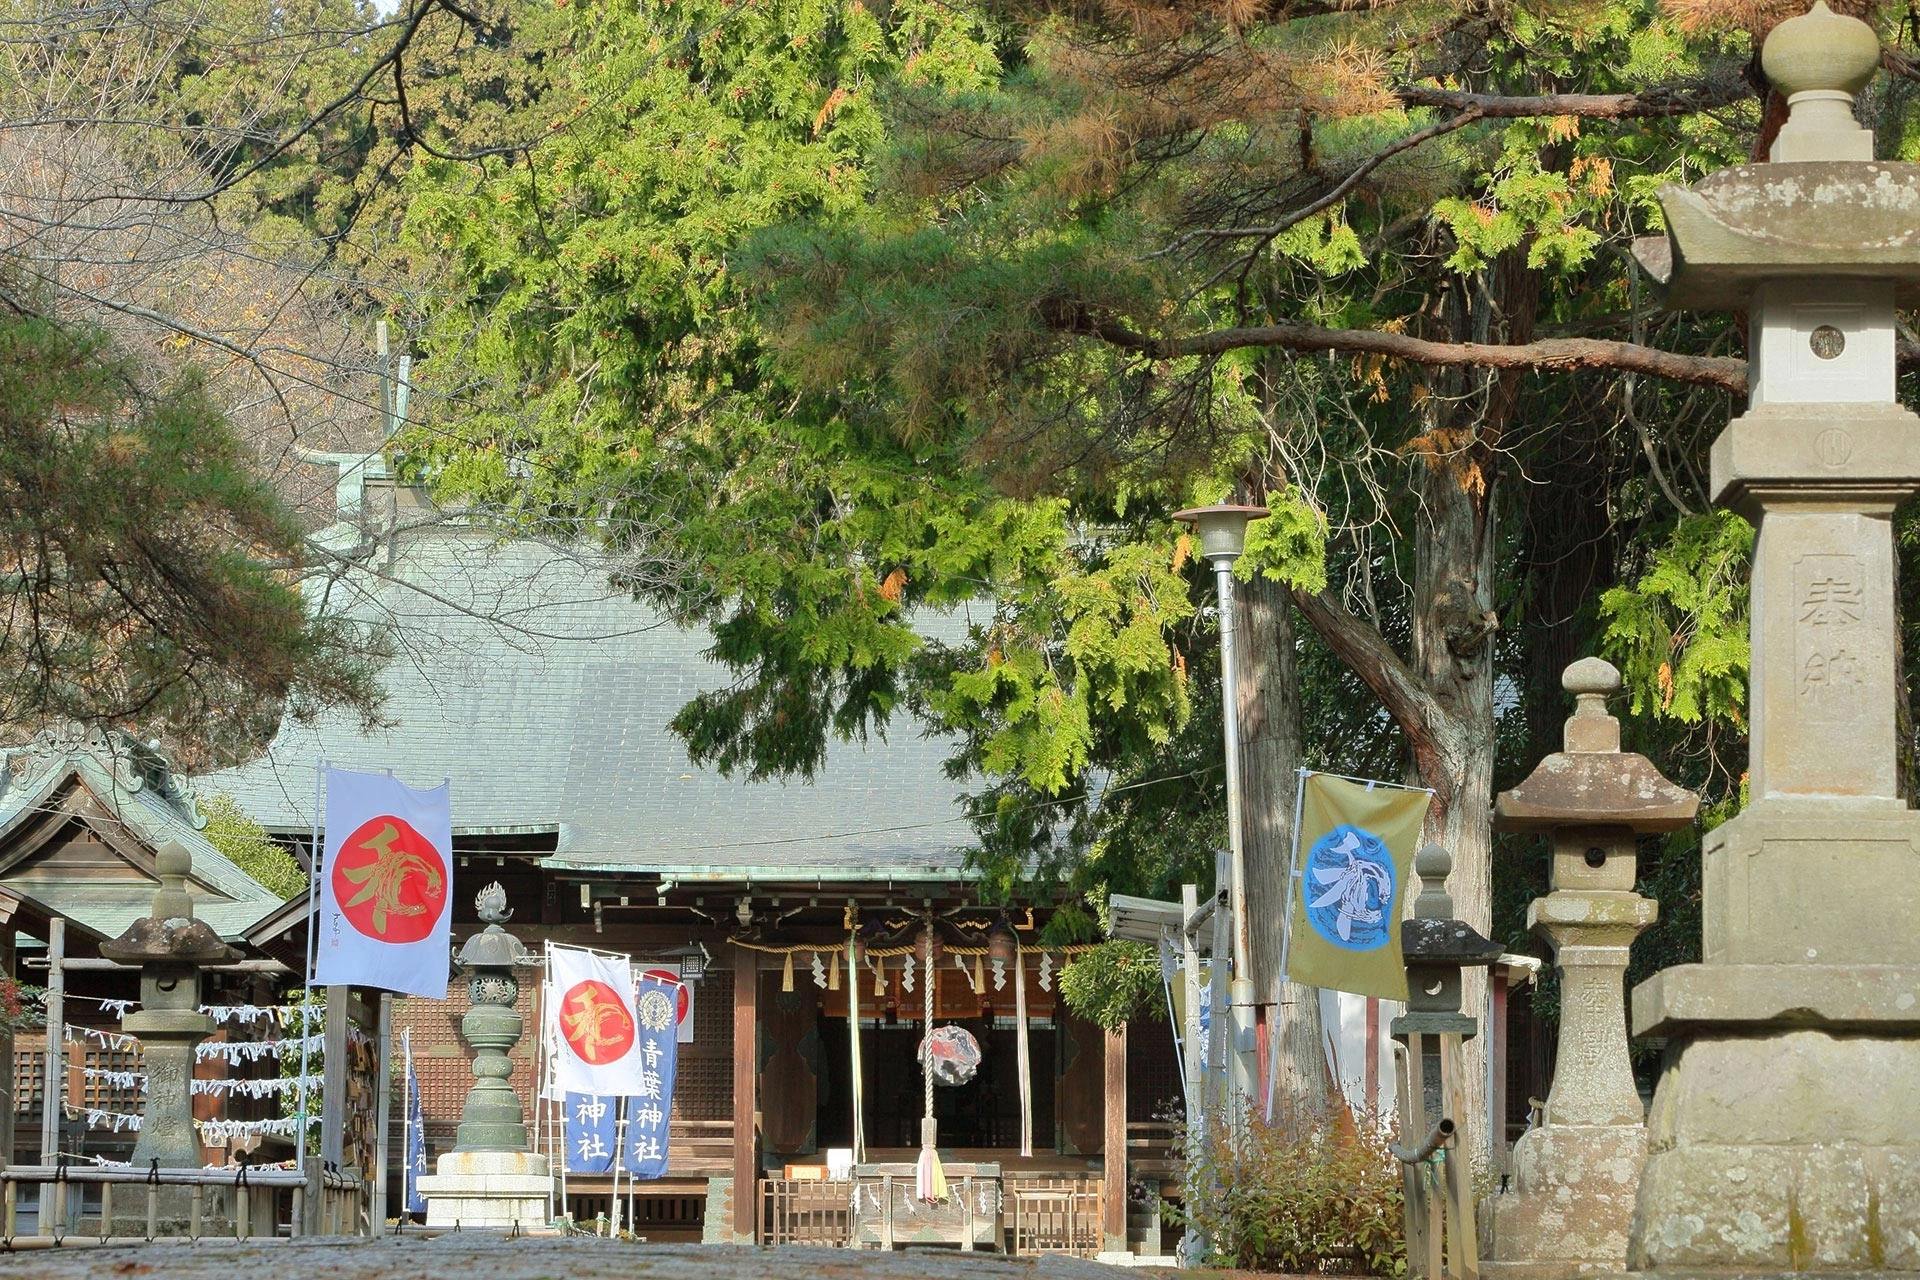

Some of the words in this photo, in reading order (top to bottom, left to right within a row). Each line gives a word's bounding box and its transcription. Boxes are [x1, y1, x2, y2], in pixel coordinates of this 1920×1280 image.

[1799, 577, 1862, 696] 奉納
[633, 1038, 664, 1164] 青葉神社
